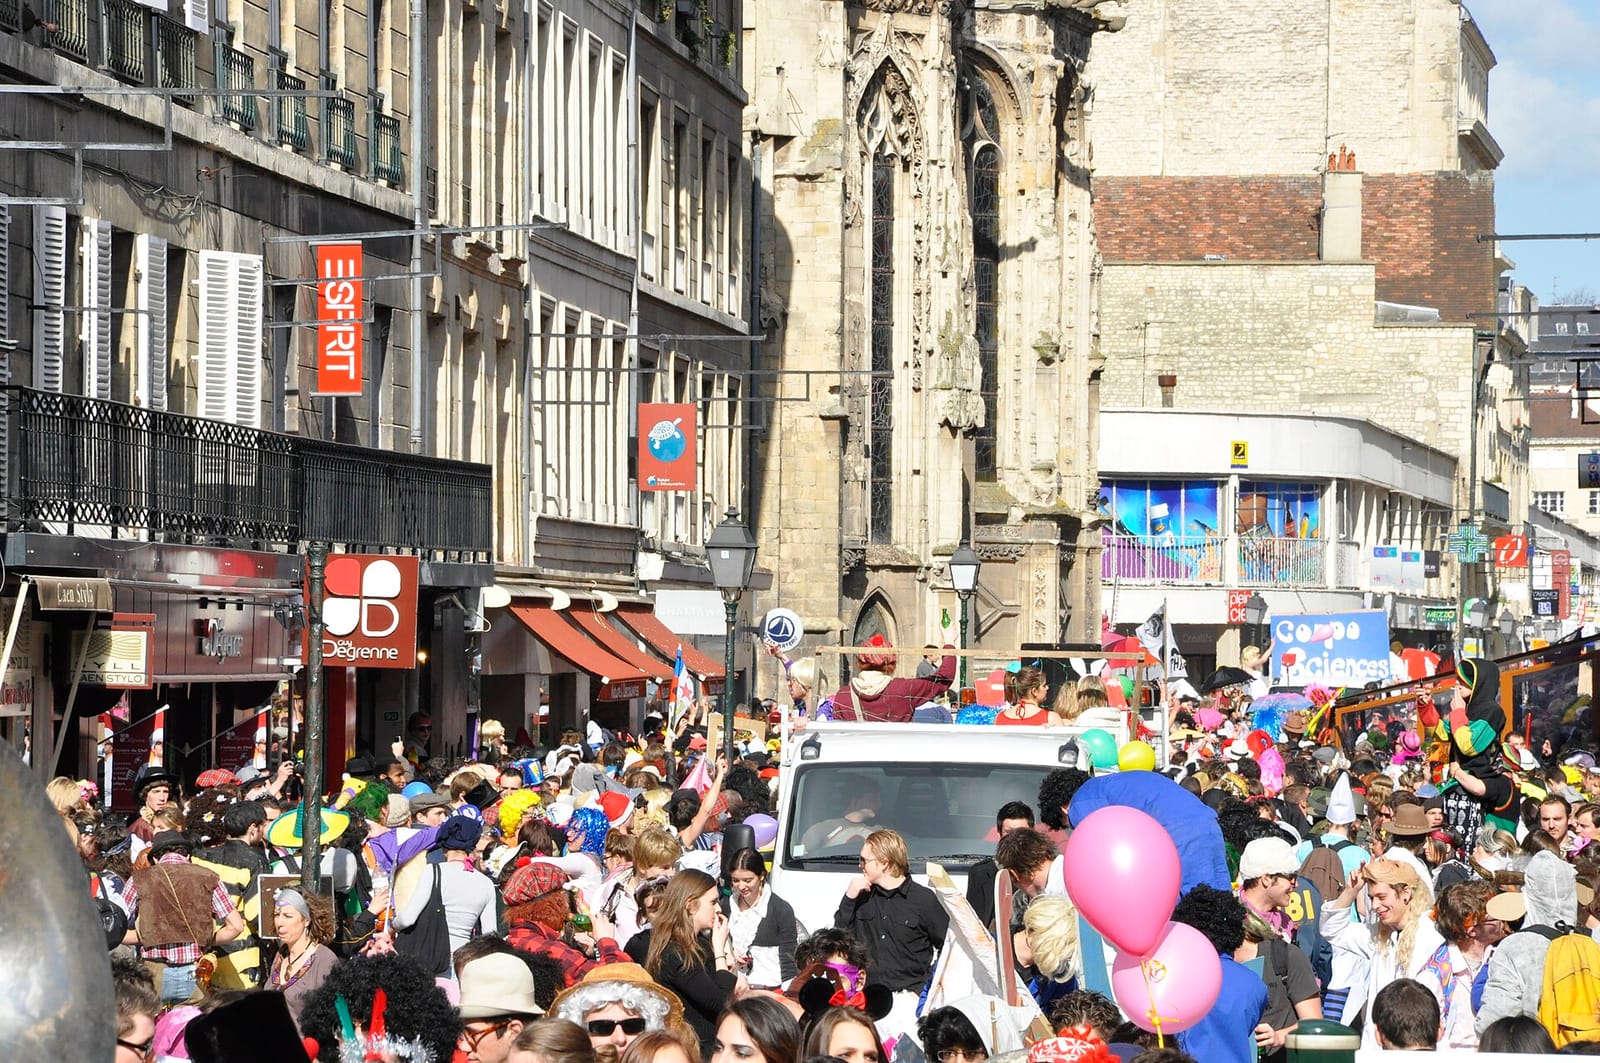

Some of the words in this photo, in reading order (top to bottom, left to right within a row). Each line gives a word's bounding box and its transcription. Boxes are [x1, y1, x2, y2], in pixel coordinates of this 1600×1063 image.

[325, 259, 355, 380] ESPRIT
[57, 583, 75, 603] Caen
[75, 661, 141, 670] YLL
[1279, 647, 1389, 681] Sciences
[72, 673, 104, 682] AEN
[106, 674, 143, 683] STYLO
